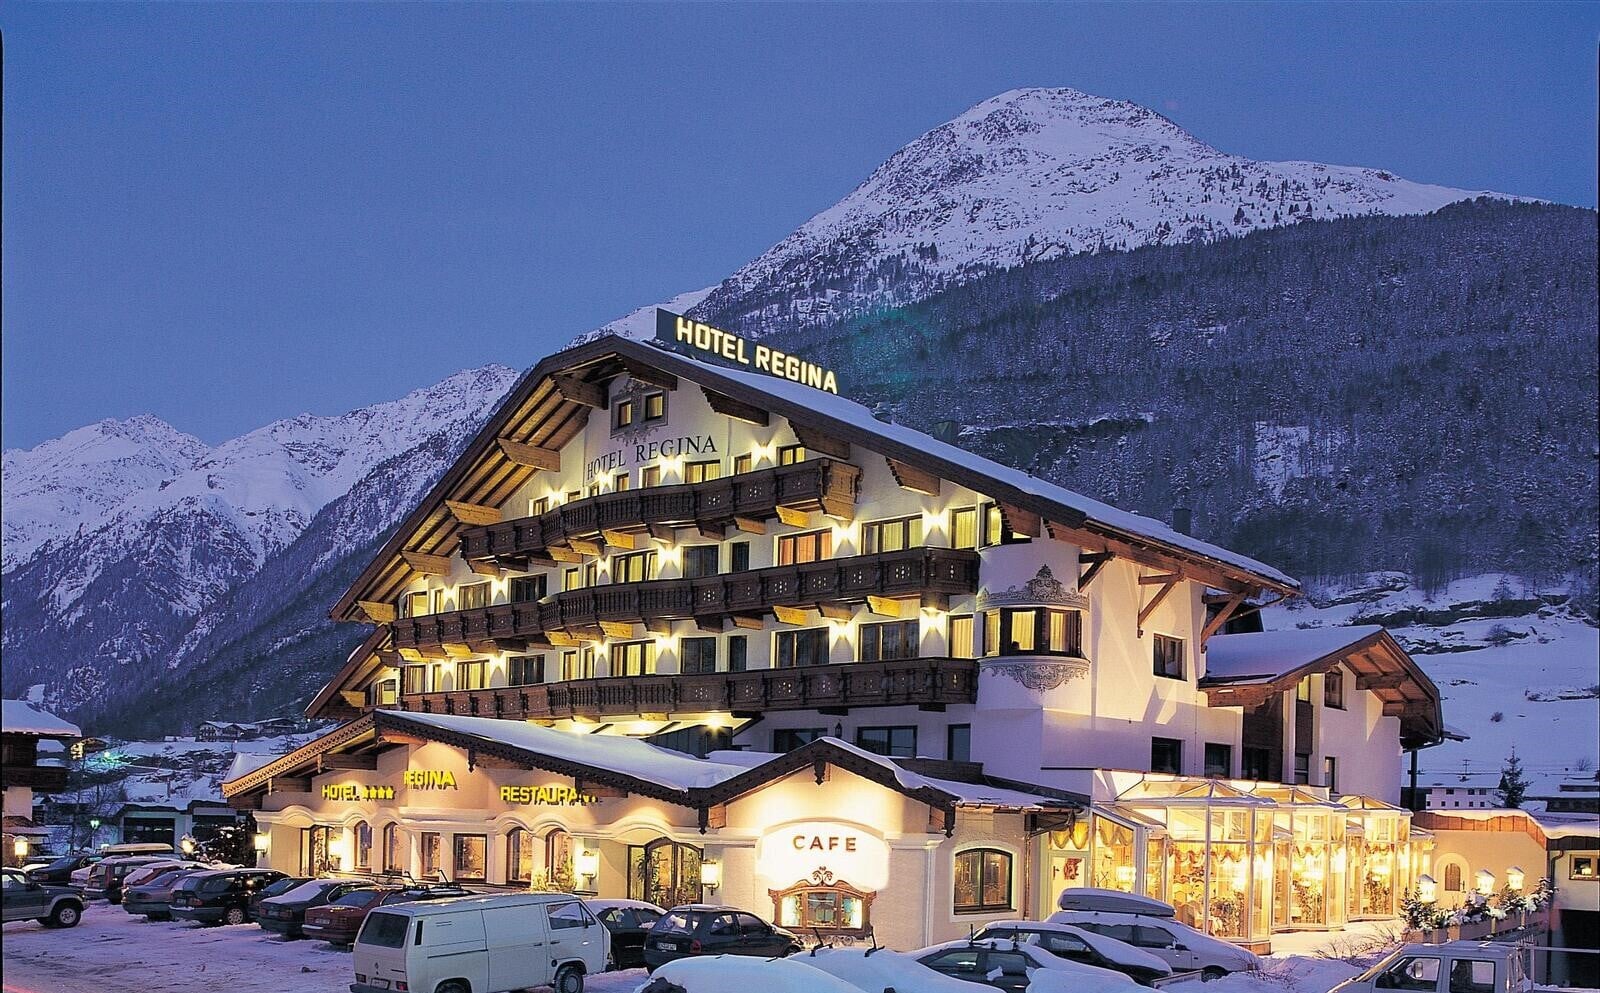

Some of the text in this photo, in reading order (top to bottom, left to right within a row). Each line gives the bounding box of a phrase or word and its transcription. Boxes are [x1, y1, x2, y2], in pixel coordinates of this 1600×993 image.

[676, 316, 838, 394] HOTEL REGINA
[587, 435, 717, 480] HOTEL REGINA
[321, 784, 358, 799] HOTEL
[500, 786, 596, 803] RESTAURA
[793, 835, 857, 851] CAFE
